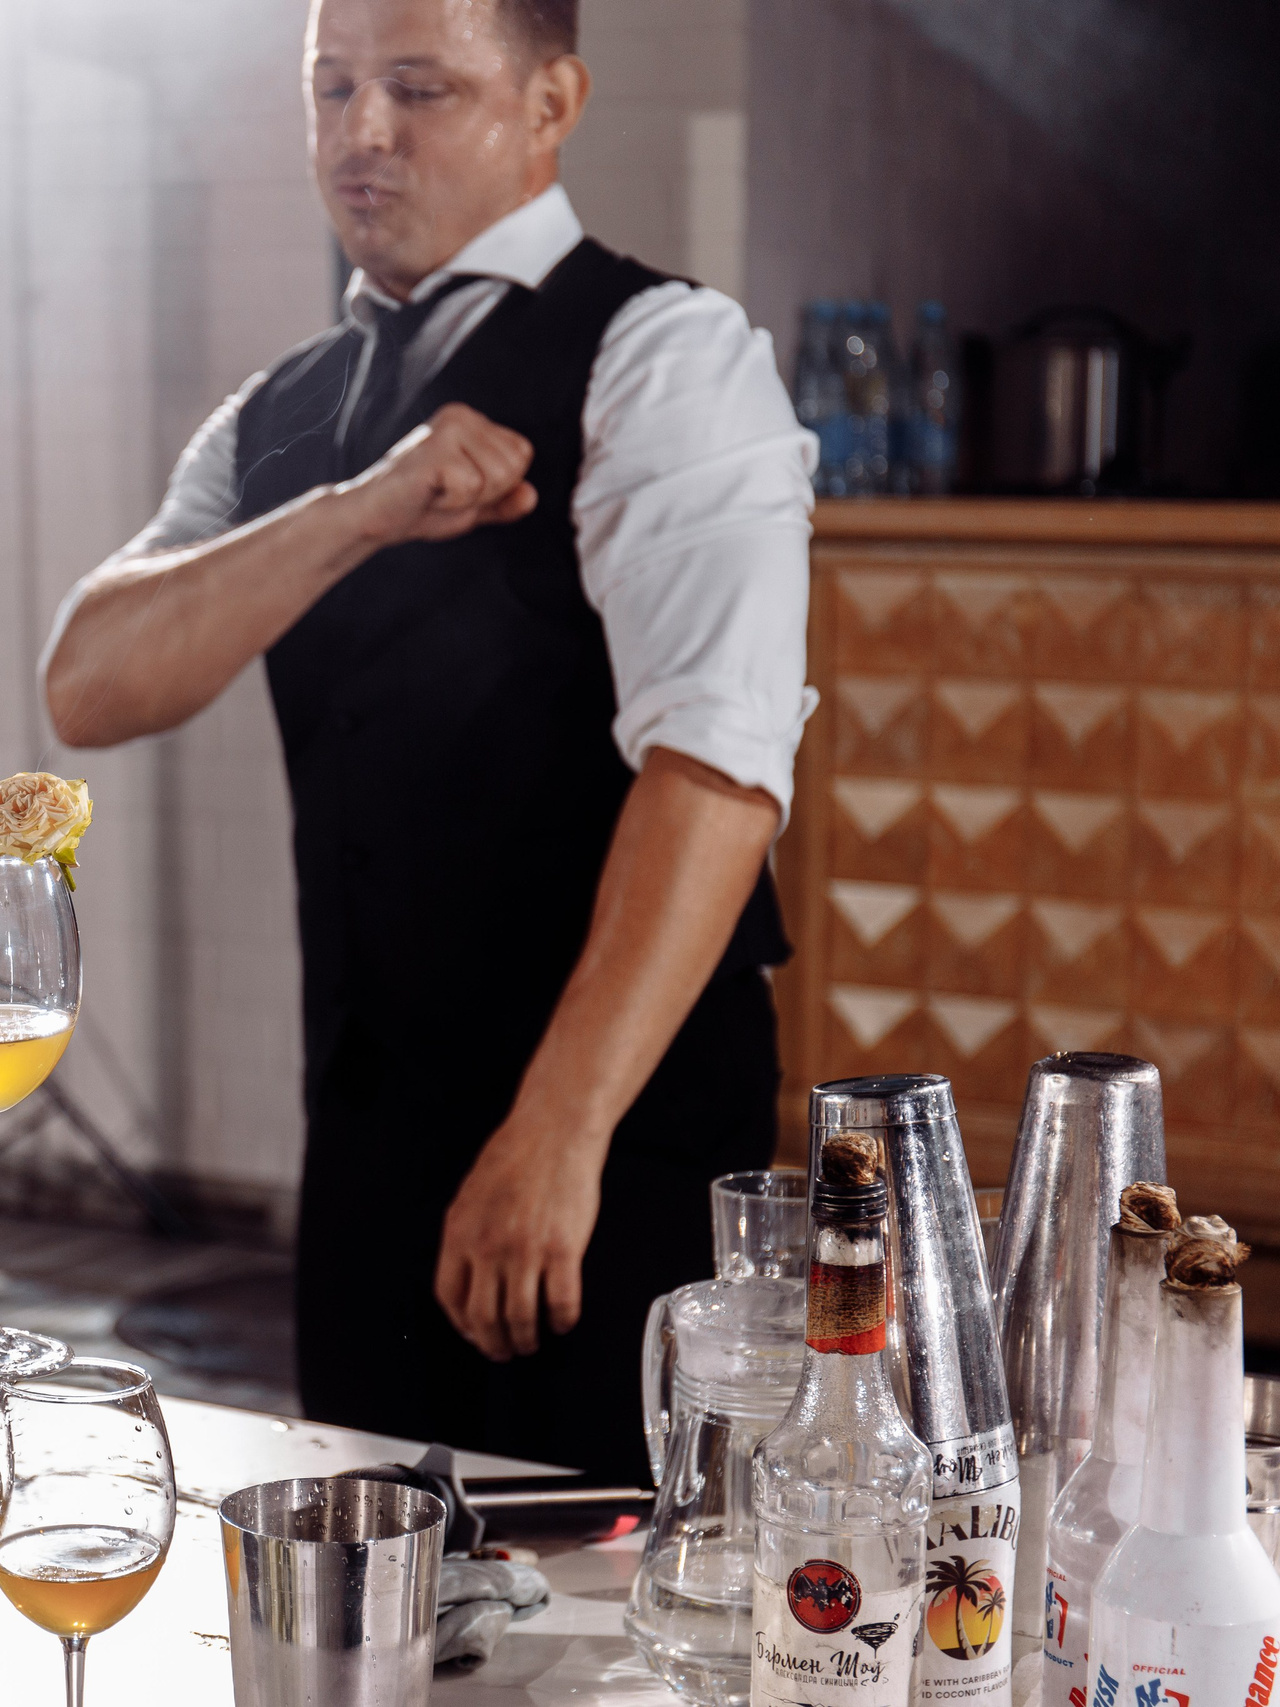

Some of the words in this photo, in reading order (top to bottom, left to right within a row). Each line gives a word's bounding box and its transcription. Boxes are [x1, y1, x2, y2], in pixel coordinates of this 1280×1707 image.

[926, 1503, 1019, 1551] ALIB
[756, 1631, 824, 1674] Бармен
[830, 1650, 886, 1687] Шоу
[1132, 1664, 1187, 1676] OFFICIAL
[934, 1678, 959, 1687] WITH
[935, 1688, 981, 1699] COCONUT
